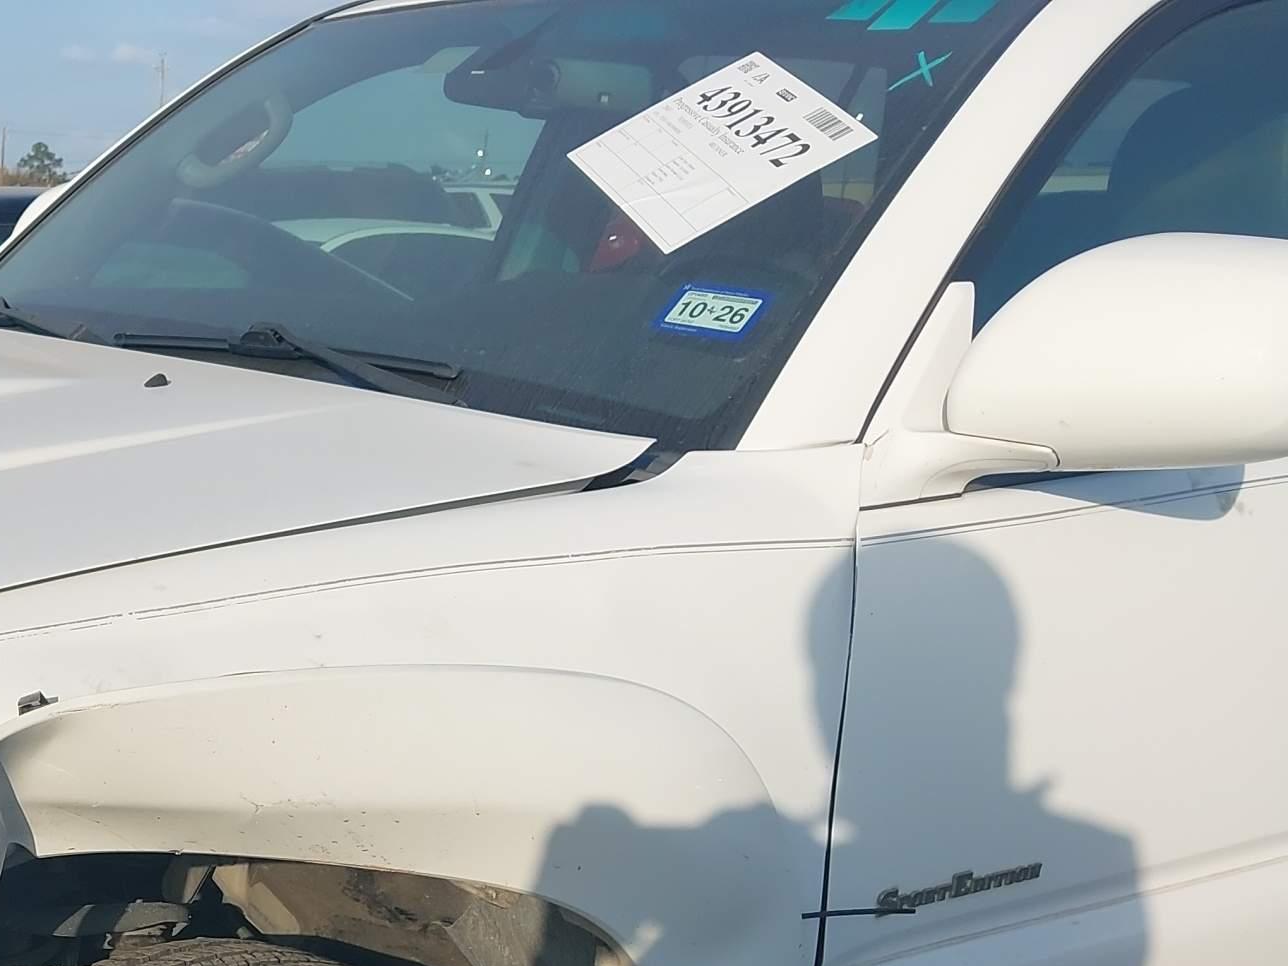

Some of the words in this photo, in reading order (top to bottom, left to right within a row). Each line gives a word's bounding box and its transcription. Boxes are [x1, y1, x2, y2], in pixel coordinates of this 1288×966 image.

[696, 86, 811, 168] 43913472
[678, 300, 708, 319] 10
[712, 304, 749, 325] 26
